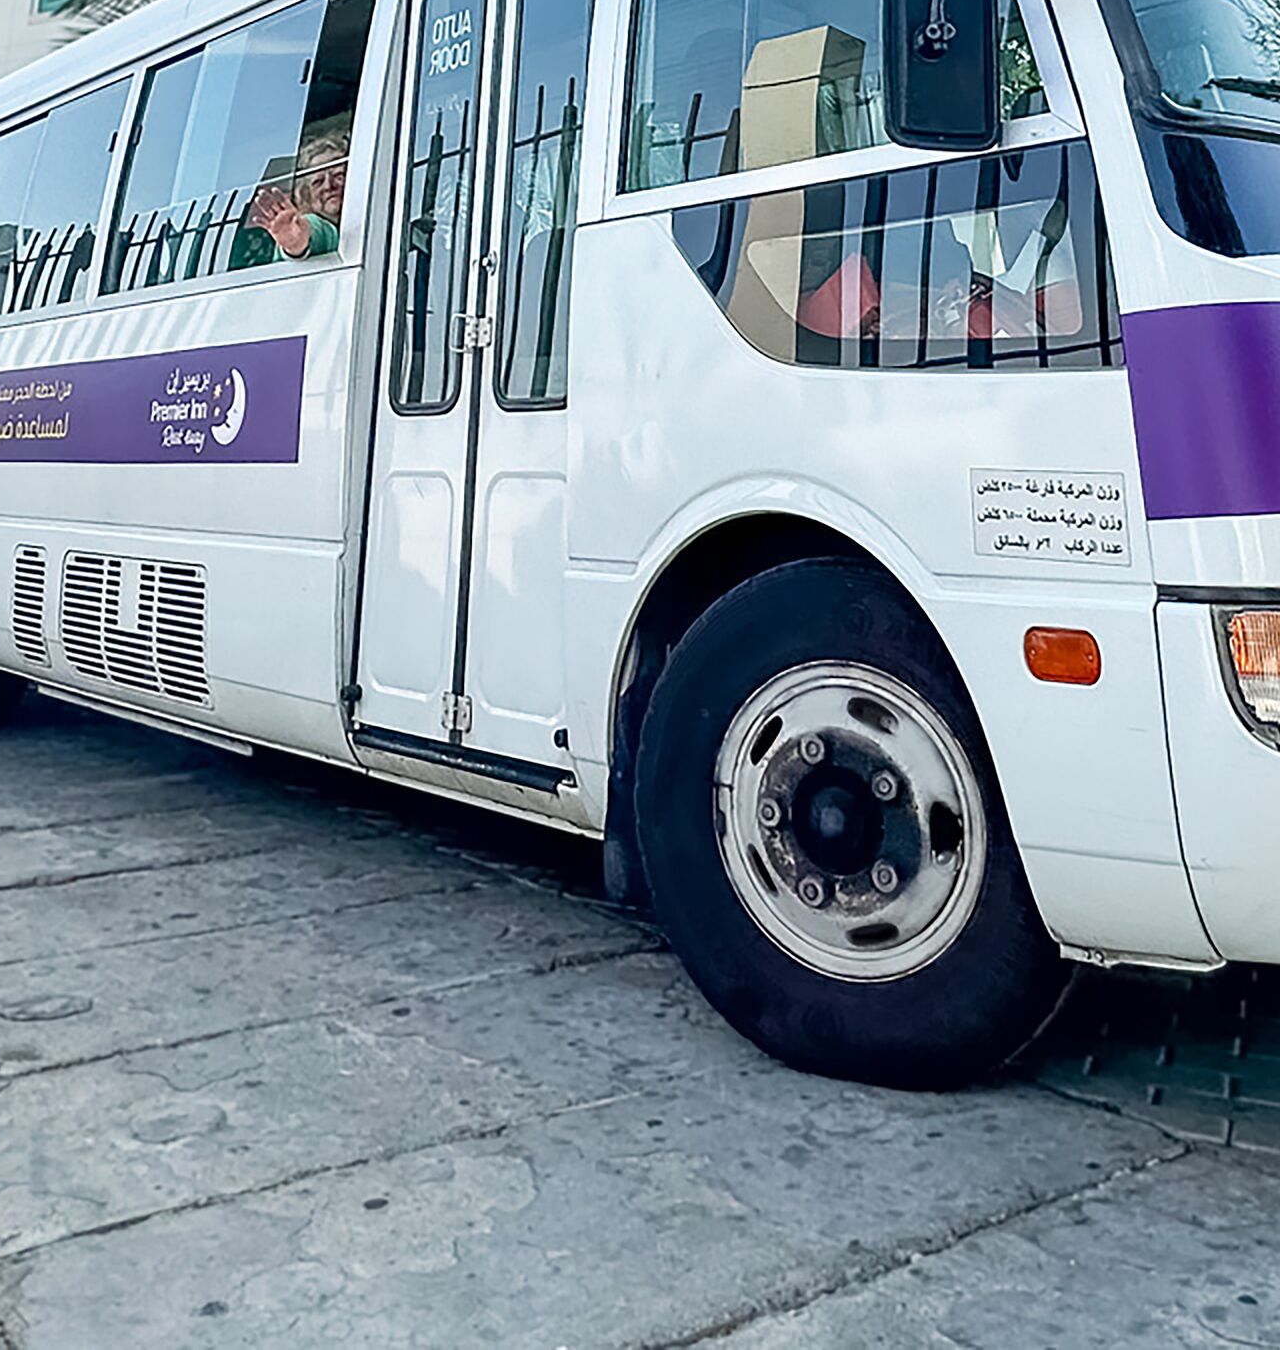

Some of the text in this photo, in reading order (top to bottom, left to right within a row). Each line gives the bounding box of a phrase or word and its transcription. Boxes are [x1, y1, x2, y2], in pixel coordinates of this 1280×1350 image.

[150, 398, 190, 422] Premier
[1097, 484, 1121, 501] وزن
[1099, 514, 1123, 531] وزن
